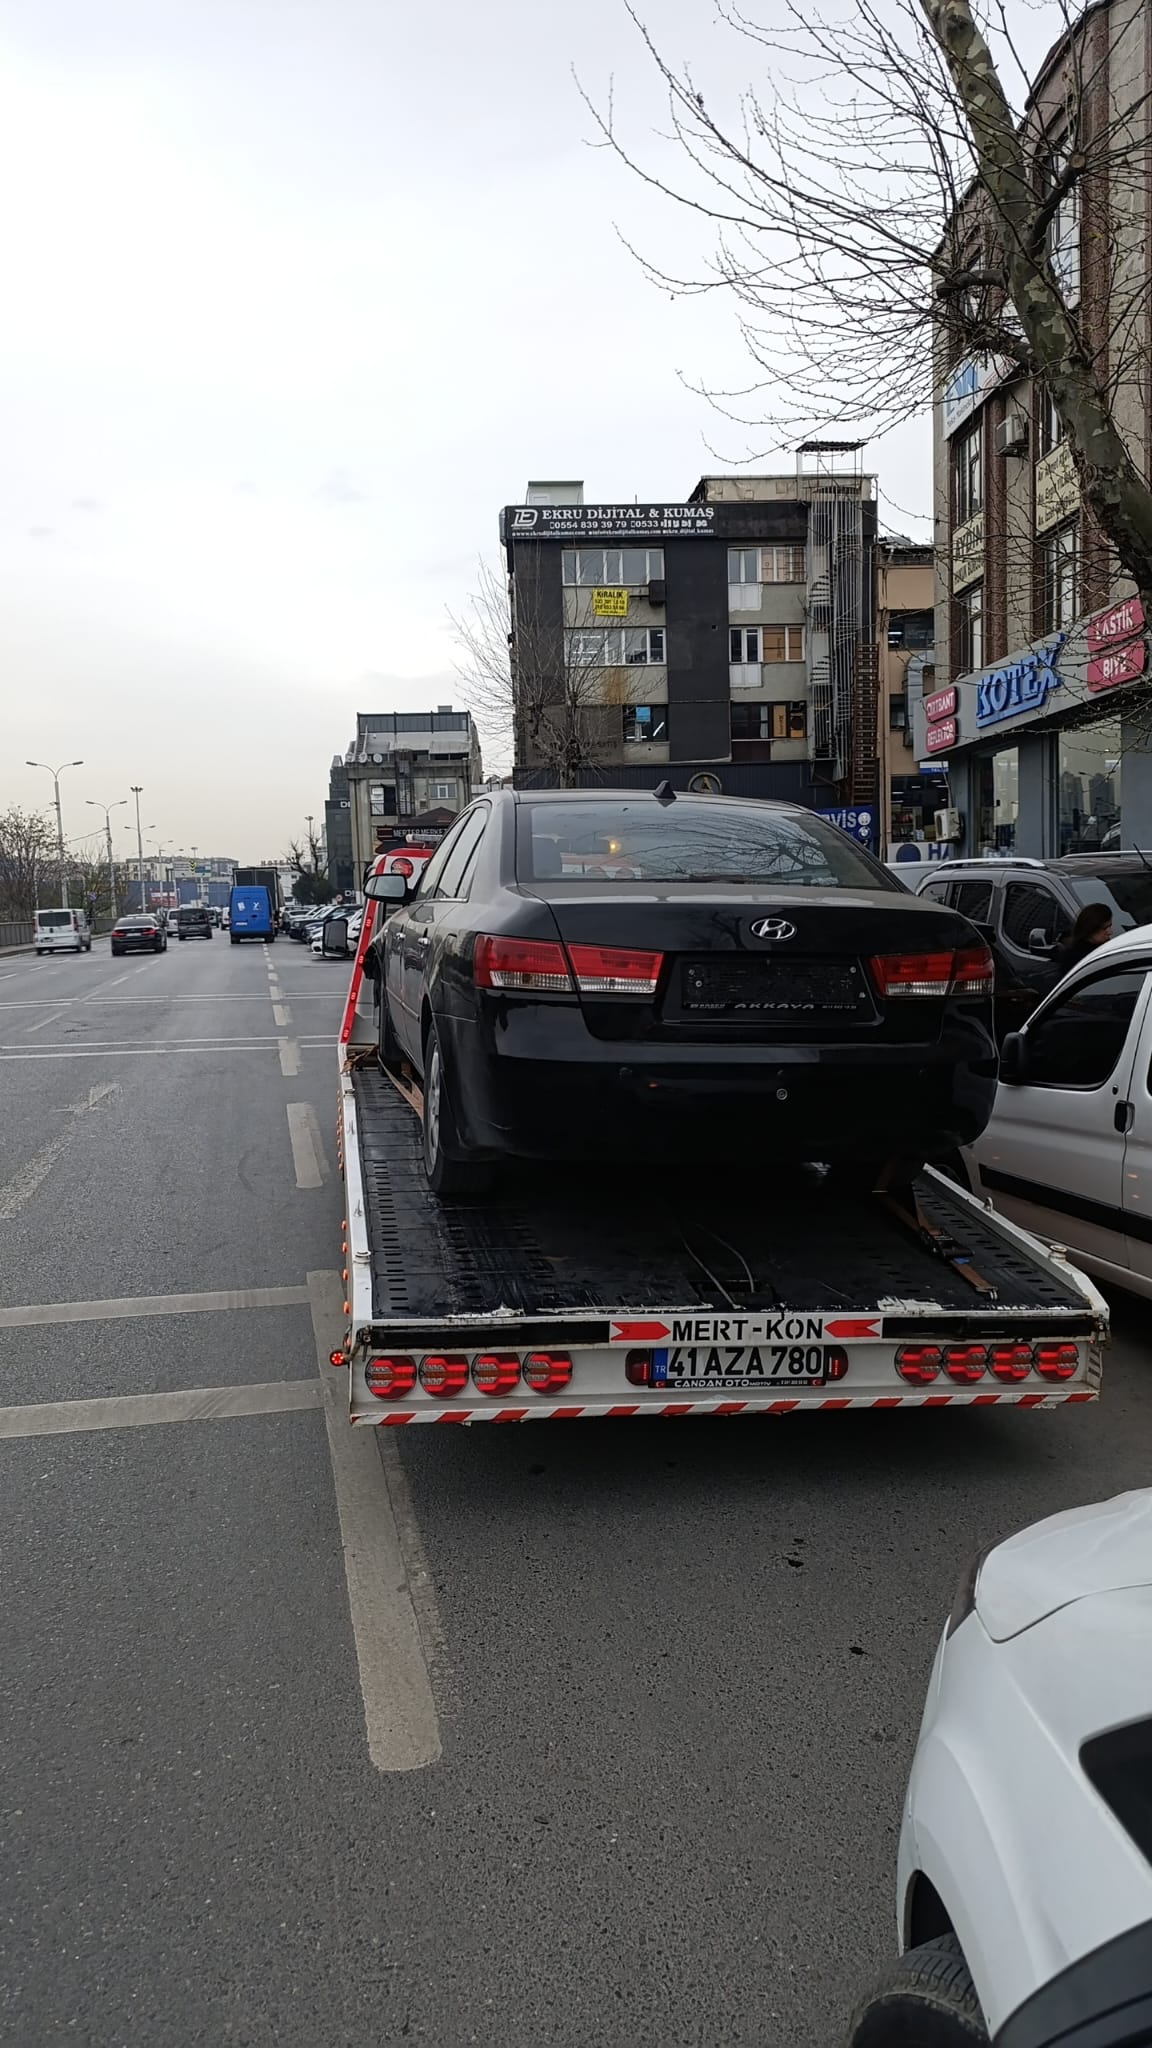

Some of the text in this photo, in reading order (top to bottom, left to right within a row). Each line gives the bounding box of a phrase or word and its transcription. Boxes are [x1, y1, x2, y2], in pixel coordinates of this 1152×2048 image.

[542, 507, 714, 520] EKRU DİJİTAL & KUMAŞ
[580, 521, 598, 529] 839
[615, 520, 627, 528] 79
[976, 634, 1064, 720] KOTEX
[655, 1365, 666, 1374] TR
[674, 1379, 724, 1388] CANDAN
